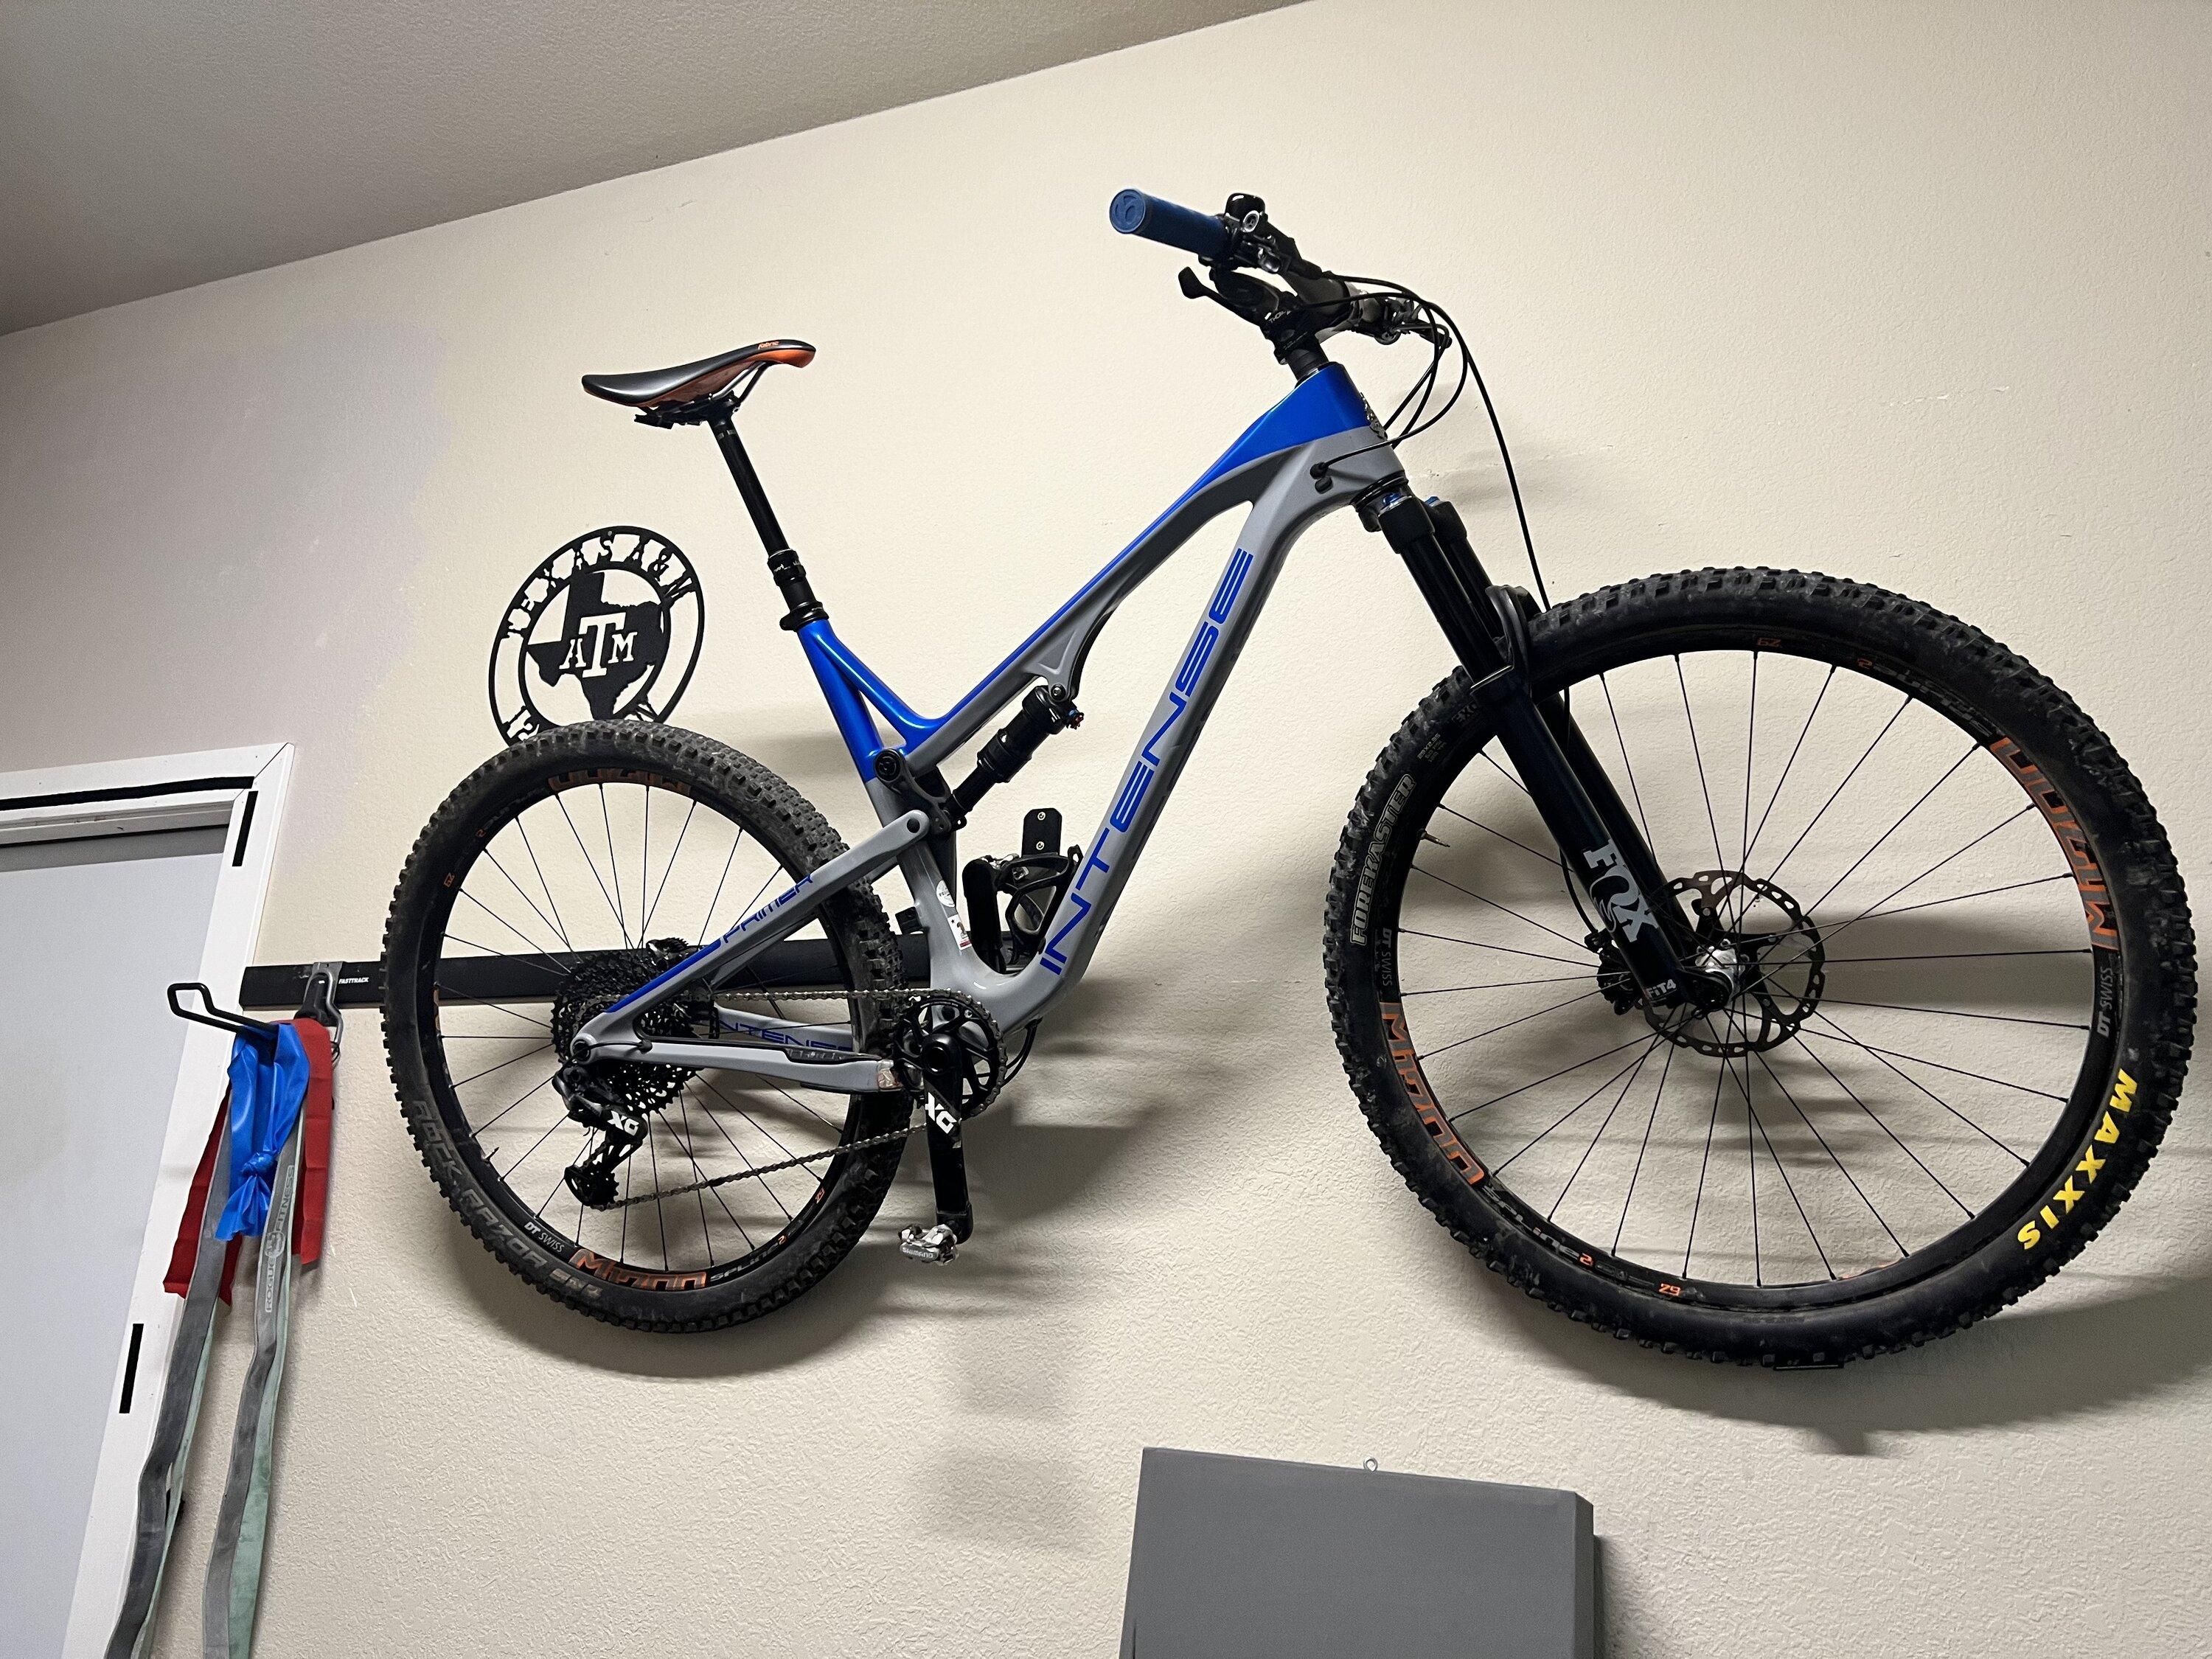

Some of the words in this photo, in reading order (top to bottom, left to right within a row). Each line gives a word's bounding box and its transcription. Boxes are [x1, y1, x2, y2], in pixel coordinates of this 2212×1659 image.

[1040, 548, 1254, 975] INTENSE
[1350, 774, 1416, 945] FOREKASTER
[1583, 838, 1659, 943] FOX
[723, 873, 813, 944] PRIMER
[1381, 950, 1393, 987] SWISS
[2100, 966, 2114, 1011] SWISS
[2097, 1012, 2113, 1038] DT
[2017, 1068, 2138, 1250] MAXXIS
[274, 1165, 295, 1233] FITNESS
[524, 1222, 541, 1234] DT
[538, 1232, 565, 1253] SWISS
[902, 1247, 933, 1258] SHIMANO
